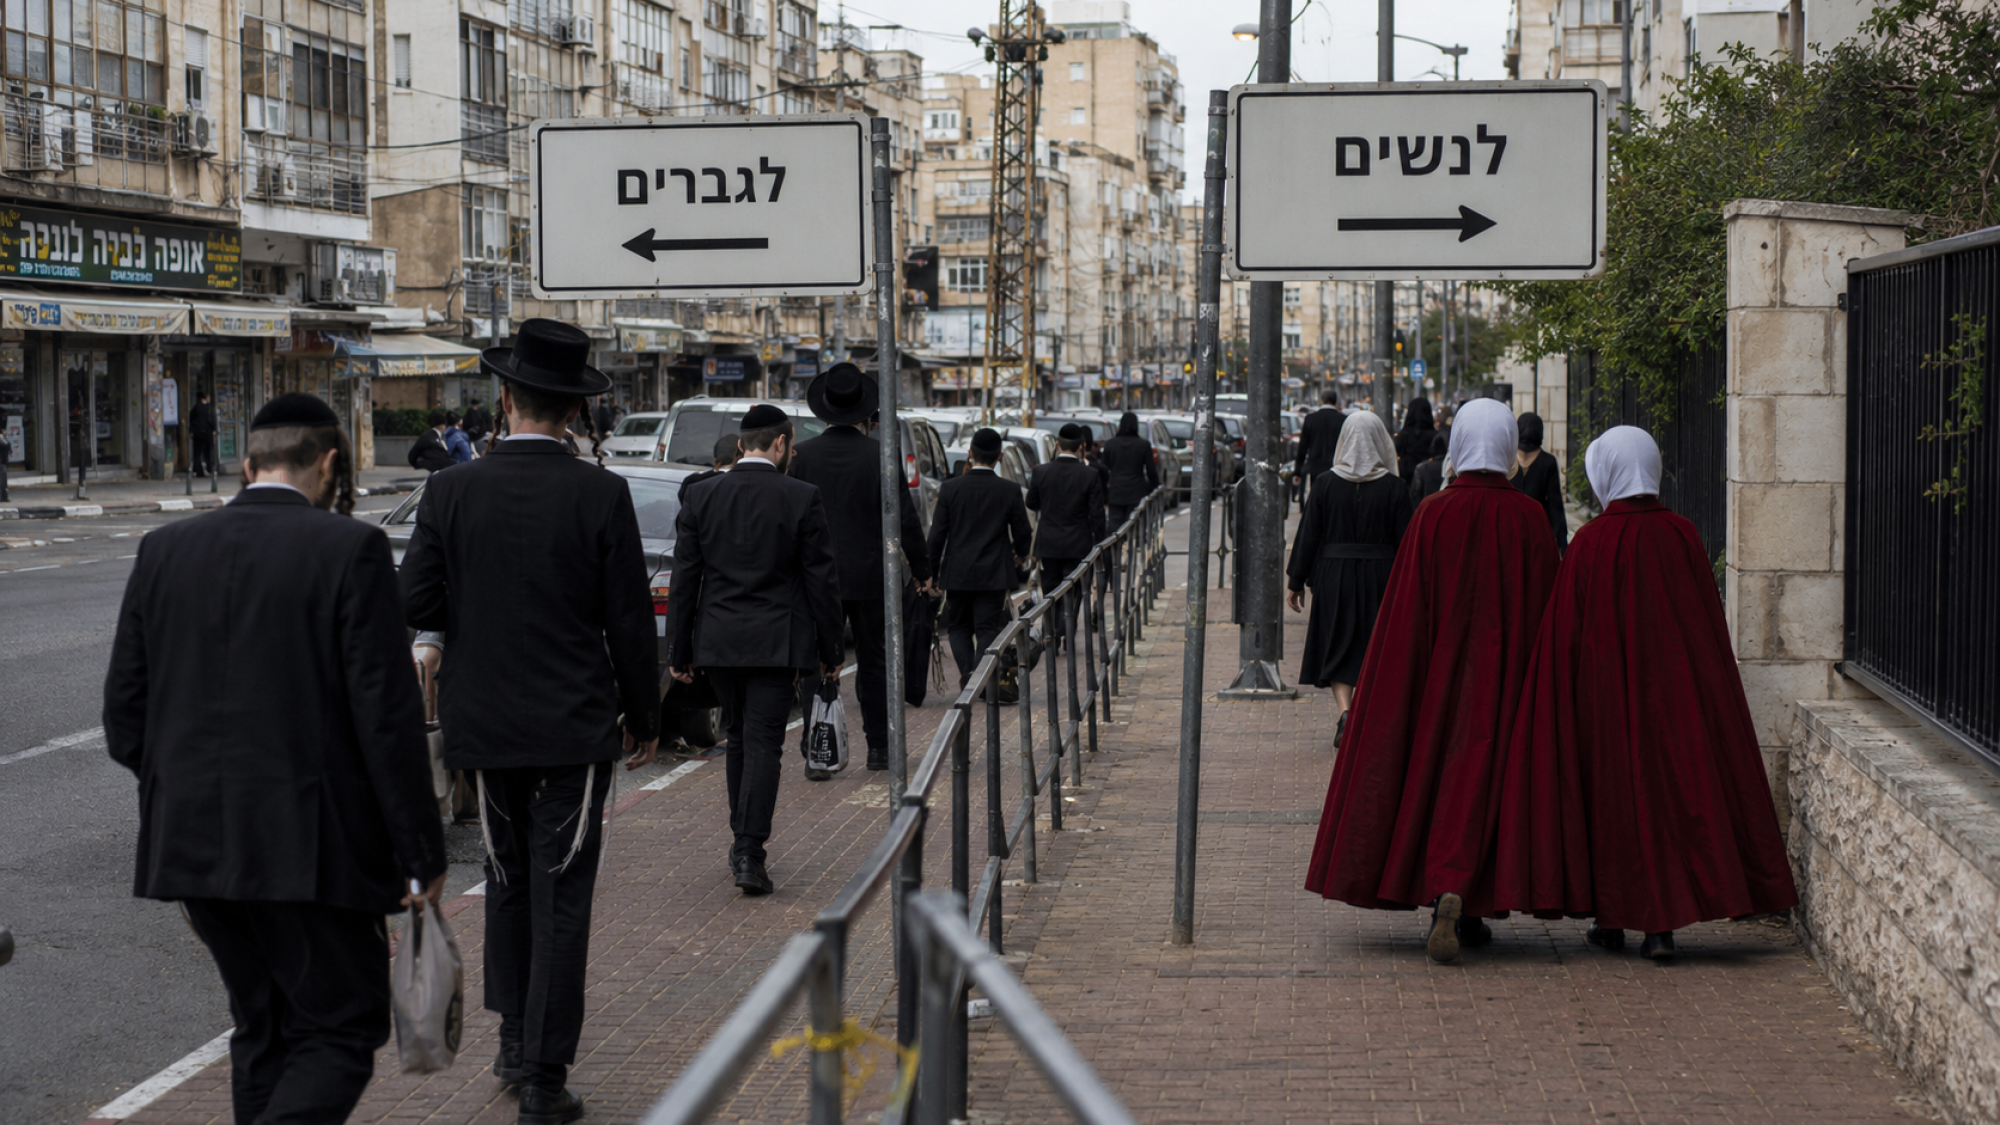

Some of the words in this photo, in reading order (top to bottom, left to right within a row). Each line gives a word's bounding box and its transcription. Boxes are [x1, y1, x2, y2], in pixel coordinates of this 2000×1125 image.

[1335, 123, 1507, 177] לנשים
[617, 156, 786, 206] לגברים
[154, 237, 205, 274] אופה
